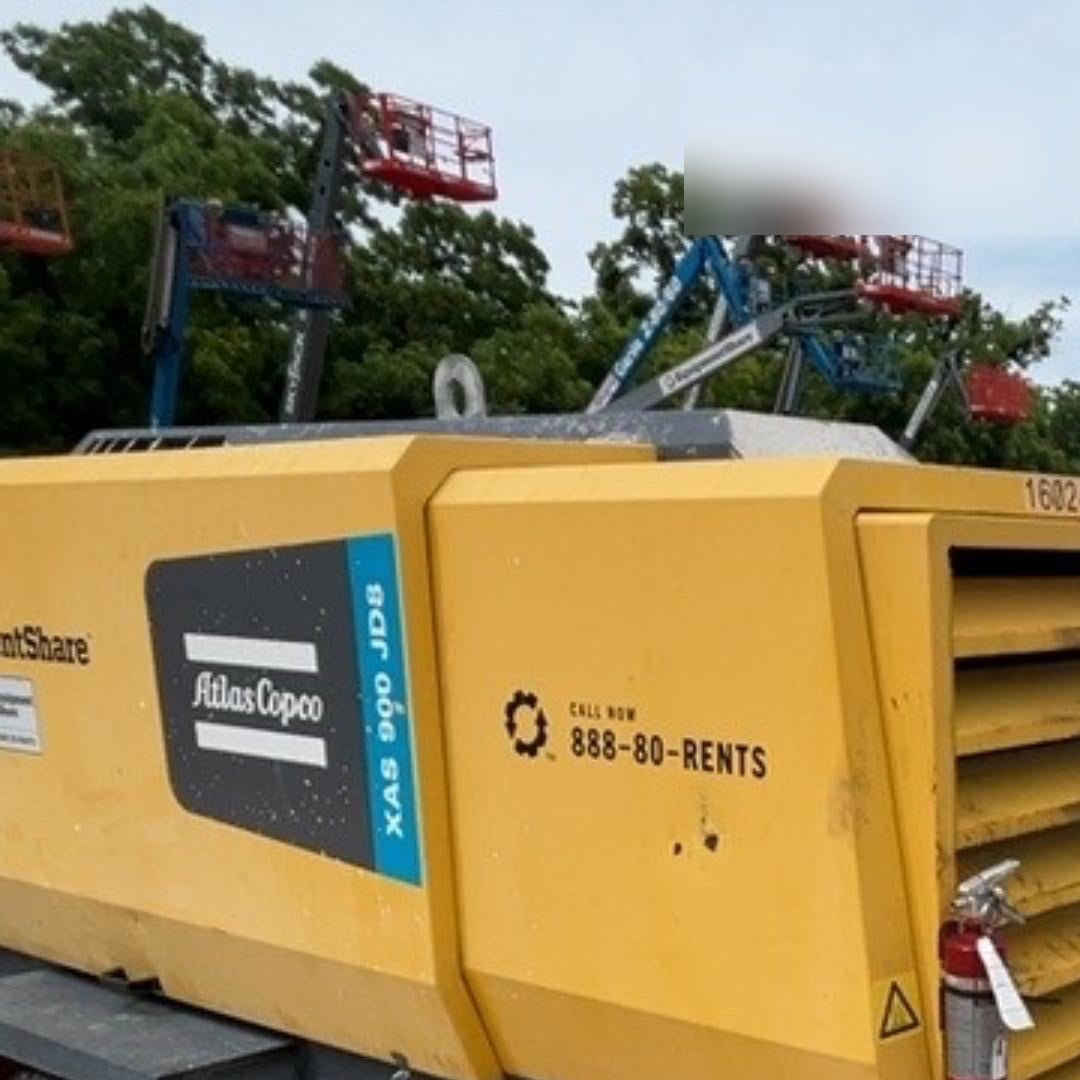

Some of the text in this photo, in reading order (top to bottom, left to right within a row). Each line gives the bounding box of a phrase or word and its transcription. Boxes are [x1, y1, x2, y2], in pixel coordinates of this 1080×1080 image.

[0, 625, 90, 665] ntShare
[374, 672, 398, 742] 900
[569, 701, 637, 722] CALL NOW
[571, 726, 768, 780] 888-80-RENTS
[380, 757, 404, 839] XAS
